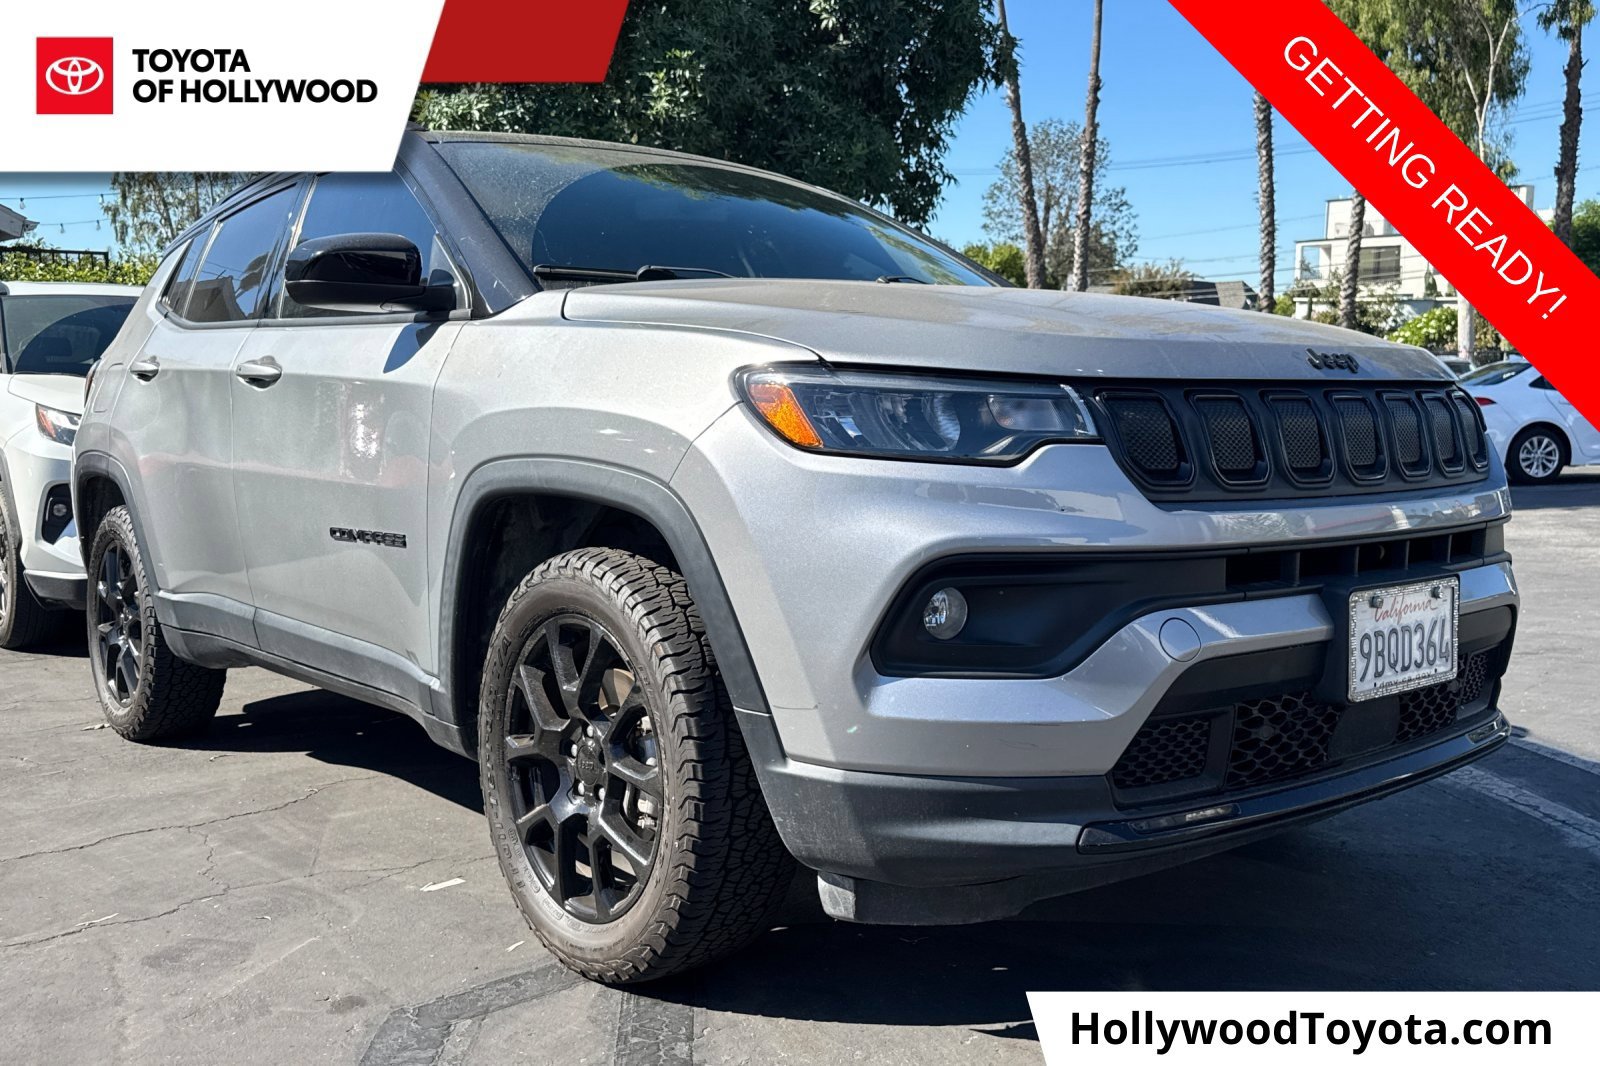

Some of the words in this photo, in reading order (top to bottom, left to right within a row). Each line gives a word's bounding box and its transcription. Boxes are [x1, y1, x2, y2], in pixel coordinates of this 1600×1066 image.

[1305, 348, 1360, 374] Jeep
[1374, 594, 1437, 624] California
[1359, 616, 1450, 682] 9BQD364
